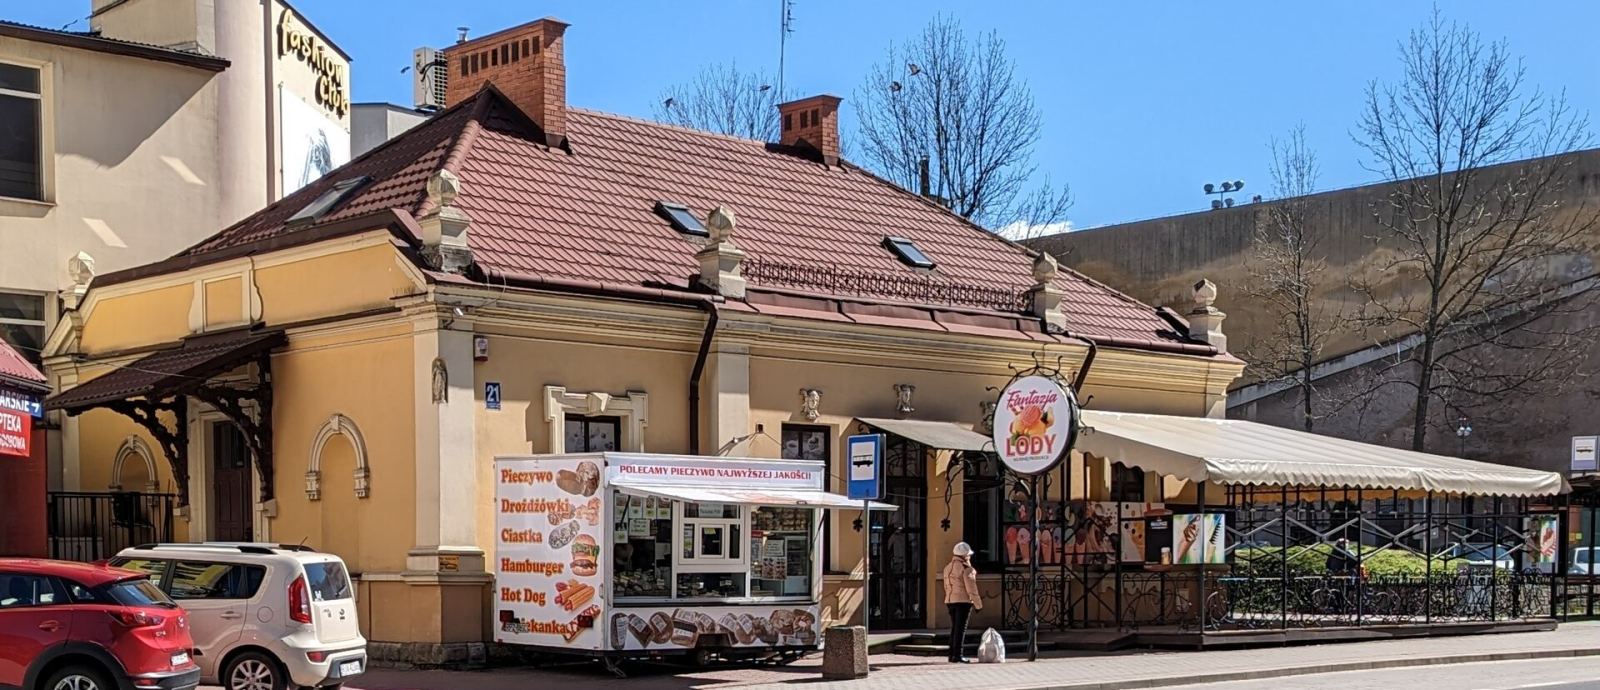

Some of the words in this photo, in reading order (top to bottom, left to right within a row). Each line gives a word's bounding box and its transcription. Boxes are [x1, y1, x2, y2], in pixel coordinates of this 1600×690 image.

[279, 8, 344, 86] fashion
[487, 385, 500, 402] 21
[1007, 390, 1057, 411] Fantazja
[1006, 434, 1056, 457] LODY
[501, 469, 553, 486] Pieczywo
[620, 465, 669, 475] POLECAMY
[671, 467, 715, 477] PIECZYWO
[717, 467, 772, 479] NAJWYŻSZEJ
[501, 498, 569, 513] Drożdżówki
[501, 528, 543, 543] Ciastka
[501, 557, 564, 576] Hamburger
[501, 587, 522, 601] Hot
[523, 588, 546, 607] Dog
